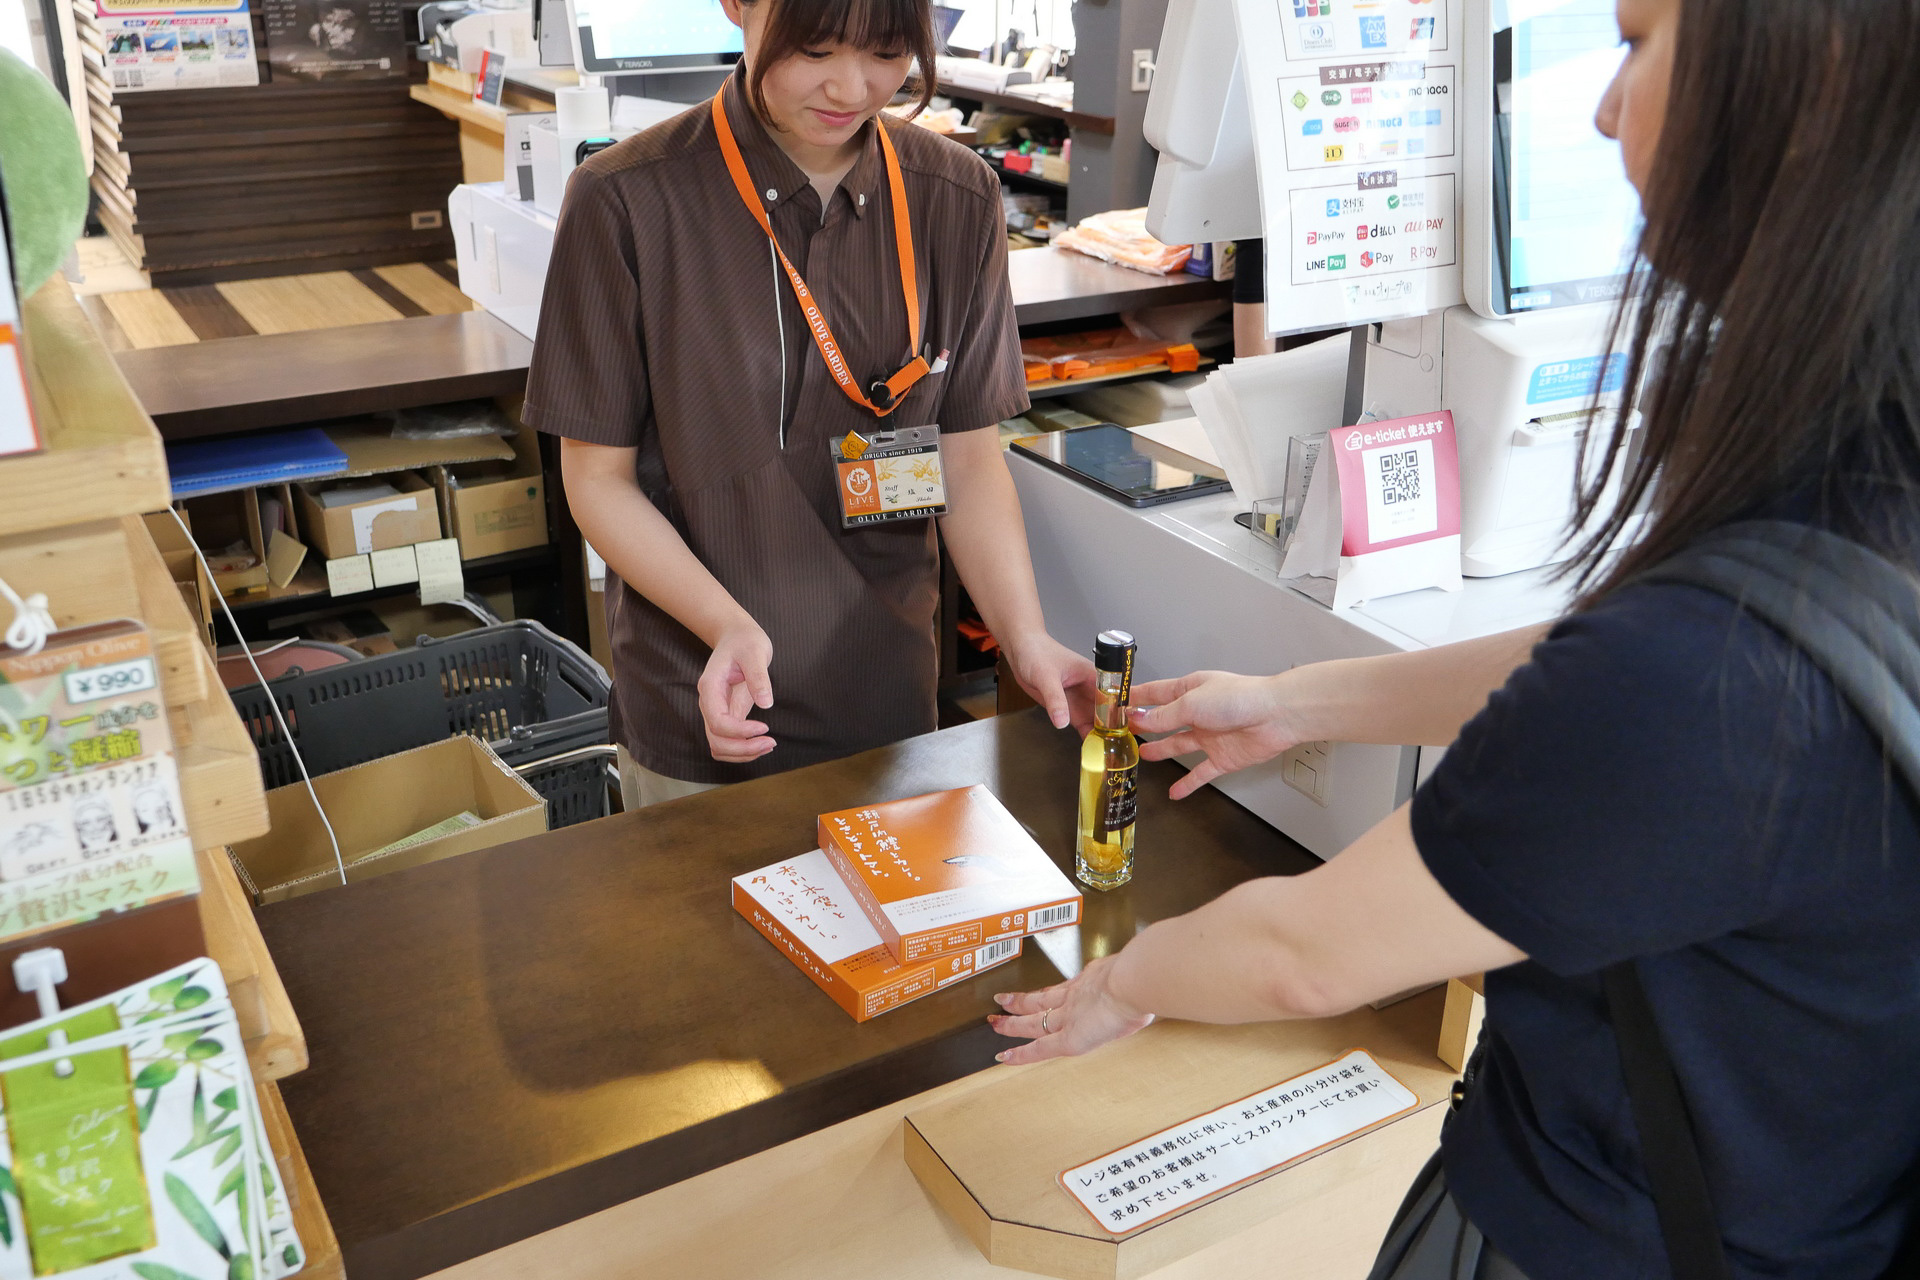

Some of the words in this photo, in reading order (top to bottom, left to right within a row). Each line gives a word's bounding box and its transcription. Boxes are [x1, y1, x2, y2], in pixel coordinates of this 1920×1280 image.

[1363, 173, 1393, 186] QR決済
[1342, 197, 1365, 208] 支付宝
[1370, 224, 1396, 238] d払い
[1404, 220, 1423, 233] au
[1426, 218, 1444, 231] PAY
[1318, 231, 1346, 243] PayPay
[1375, 252, 1394, 264] Pay
[1419, 246, 1438, 259] Pay
[1306, 259, 1326, 271] LINE
[1328, 257, 1345, 269] Pay
[792, 271, 808, 297] 1919
[806, 306, 829, 341] OLIVE
[823, 341, 851, 386] GARDEN
[1364, 427, 1406, 446] e-ticket
[1407, 420, 1444, 438] 使えます
[864, 451, 888, 460] ORIGIN
[857, 513, 888, 523] OLIVE
[896, 507, 936, 518] GARDEN
[75, 668, 144, 694] ¥990
[1079, 1063, 1366, 1188] レジ袋有料義務化に伴い、お土産用の小分け袋を
[1095, 1077, 1382, 1204] ご希望のお客様はサービスカウンターにてお買い
[1109, 1169, 1219, 1222] 求め下さいませ。
